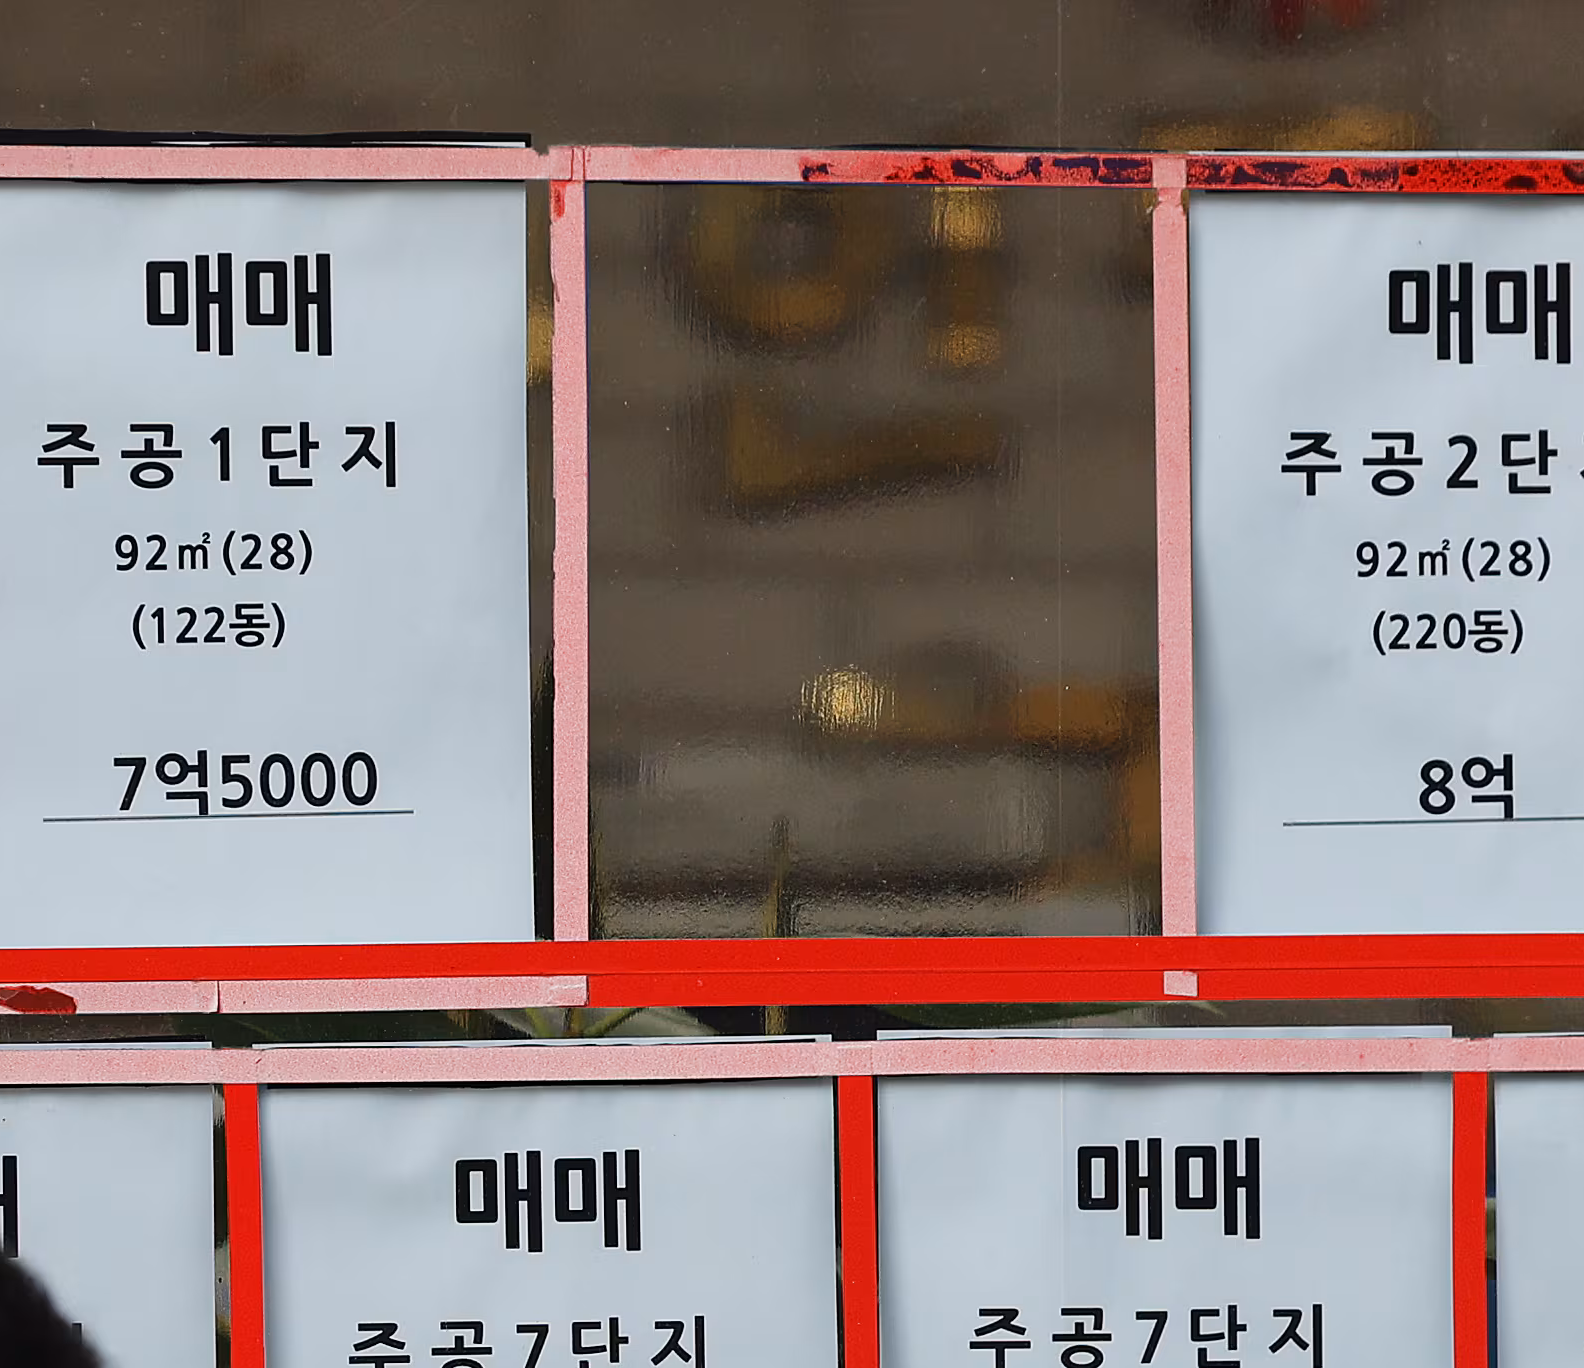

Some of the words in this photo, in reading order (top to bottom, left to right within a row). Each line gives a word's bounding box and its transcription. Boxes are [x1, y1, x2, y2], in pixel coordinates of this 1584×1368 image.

[146, 253, 332, 356] 매매
[1389, 262, 1571, 364] 매매
[37, 421, 396, 489] 주공1단지
[133, 603, 285, 649] (122동)
[1373, 609, 1523, 656] (220동)
[113, 750, 378, 816] 7억5000
[1420, 754, 1513, 822] 8억
[456, 1149, 641, 1252] 매매
[1078, 1138, 1260, 1240] 매매
